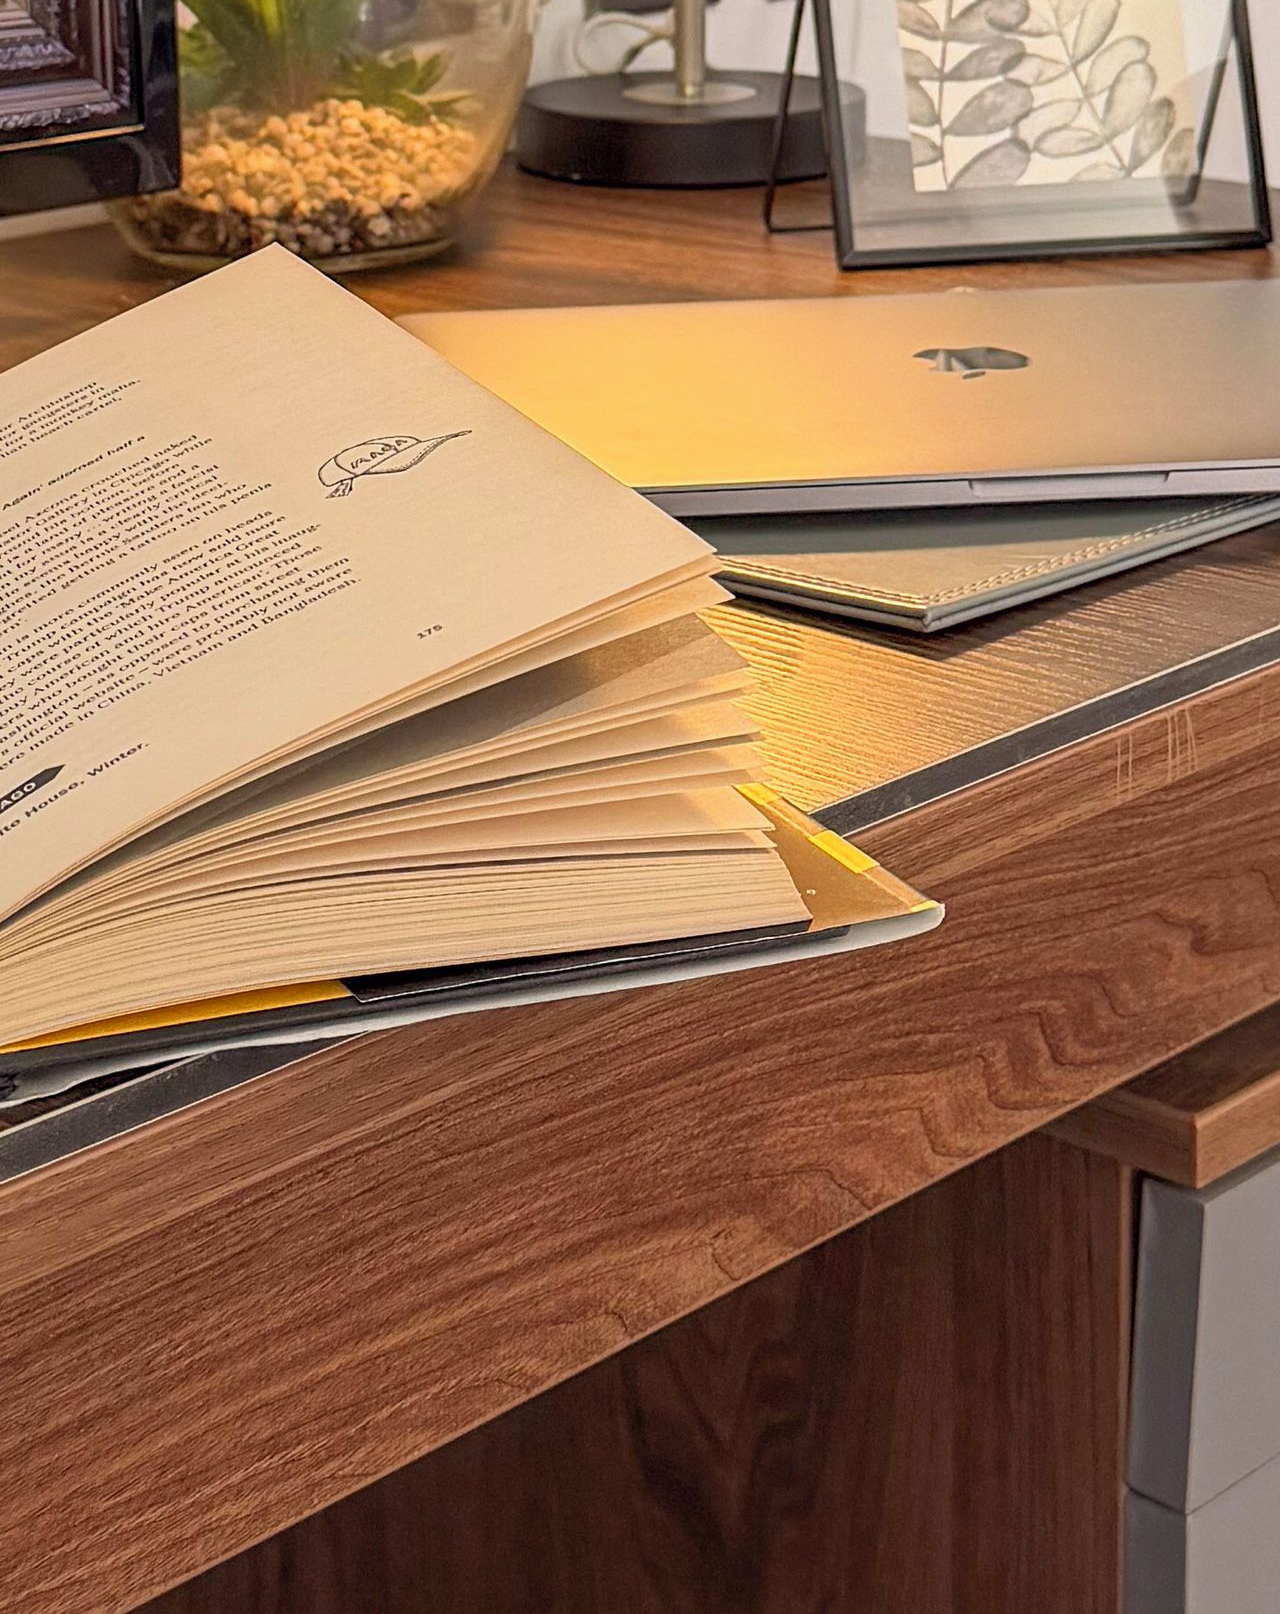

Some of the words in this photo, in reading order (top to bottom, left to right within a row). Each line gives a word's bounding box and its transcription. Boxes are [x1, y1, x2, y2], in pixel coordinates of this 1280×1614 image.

[47, 454, 103, 485] adorned
[106, 439, 131, 455] half
[2, 630, 56, 661] Trump
[60, 587, 136, 629] campaign
[139, 570, 168, 586] has
[171, 552, 203, 570] now
[208, 534, 241, 553] sold
[244, 516, 285, 536] more
[7, 649, 44, 672] caps
[47, 627, 83, 647] with
[86, 611, 112, 626] the
[168, 551, 233, 584] America
[235, 530, 279, 551] Great
[15, 634, 29, 643] is
[33, 608, 74, 633] more
[77, 563, 157, 608] commonly
[162, 544, 199, 563] seen
[202, 533, 222, 544] on
[224, 510, 272, 533] heads
[20, 653, 58, 676] were
[62, 600, 154, 653] particularly
[160, 567, 220, 601] popular
[225, 558, 241, 568] at
[243, 546, 269, 559] his
[27, 652, 81, 685] course
[85, 640, 100, 652] of
[104, 614, 153, 640] which
[154, 585, 209, 612] Trump
[214, 542, 301, 585] announced
[27, 689, 62, 710] who
[65, 654, 123, 688] bought
[126, 631, 165, 654] their
[170, 611, 208, 631] caps
[211, 590, 250, 610] from
[254, 566, 301, 591] street
[33, 649, 110, 696] American
[114, 629, 144, 649] and
[147, 612, 180, 631] hire
[270, 545, 322, 568] Those
[96, 672, 115, 684] as
[118, 631, 189, 671] opposed
[191, 622, 210, 632] to
[213, 577, 305, 623] purchasing
[306, 557, 349, 578] them
[13, 710, 68, 747] official
[72, 674, 134, 710] website
[151, 644, 192, 665] were
[195, 606, 267, 645] probably
[272, 591, 299, 607] not
[304, 568, 352, 592] aware
[29, 721, 73, 750] made
[77, 710, 94, 721] in
[152, 641, 223, 676] Vietnam
[227, 623, 258, 641] and
